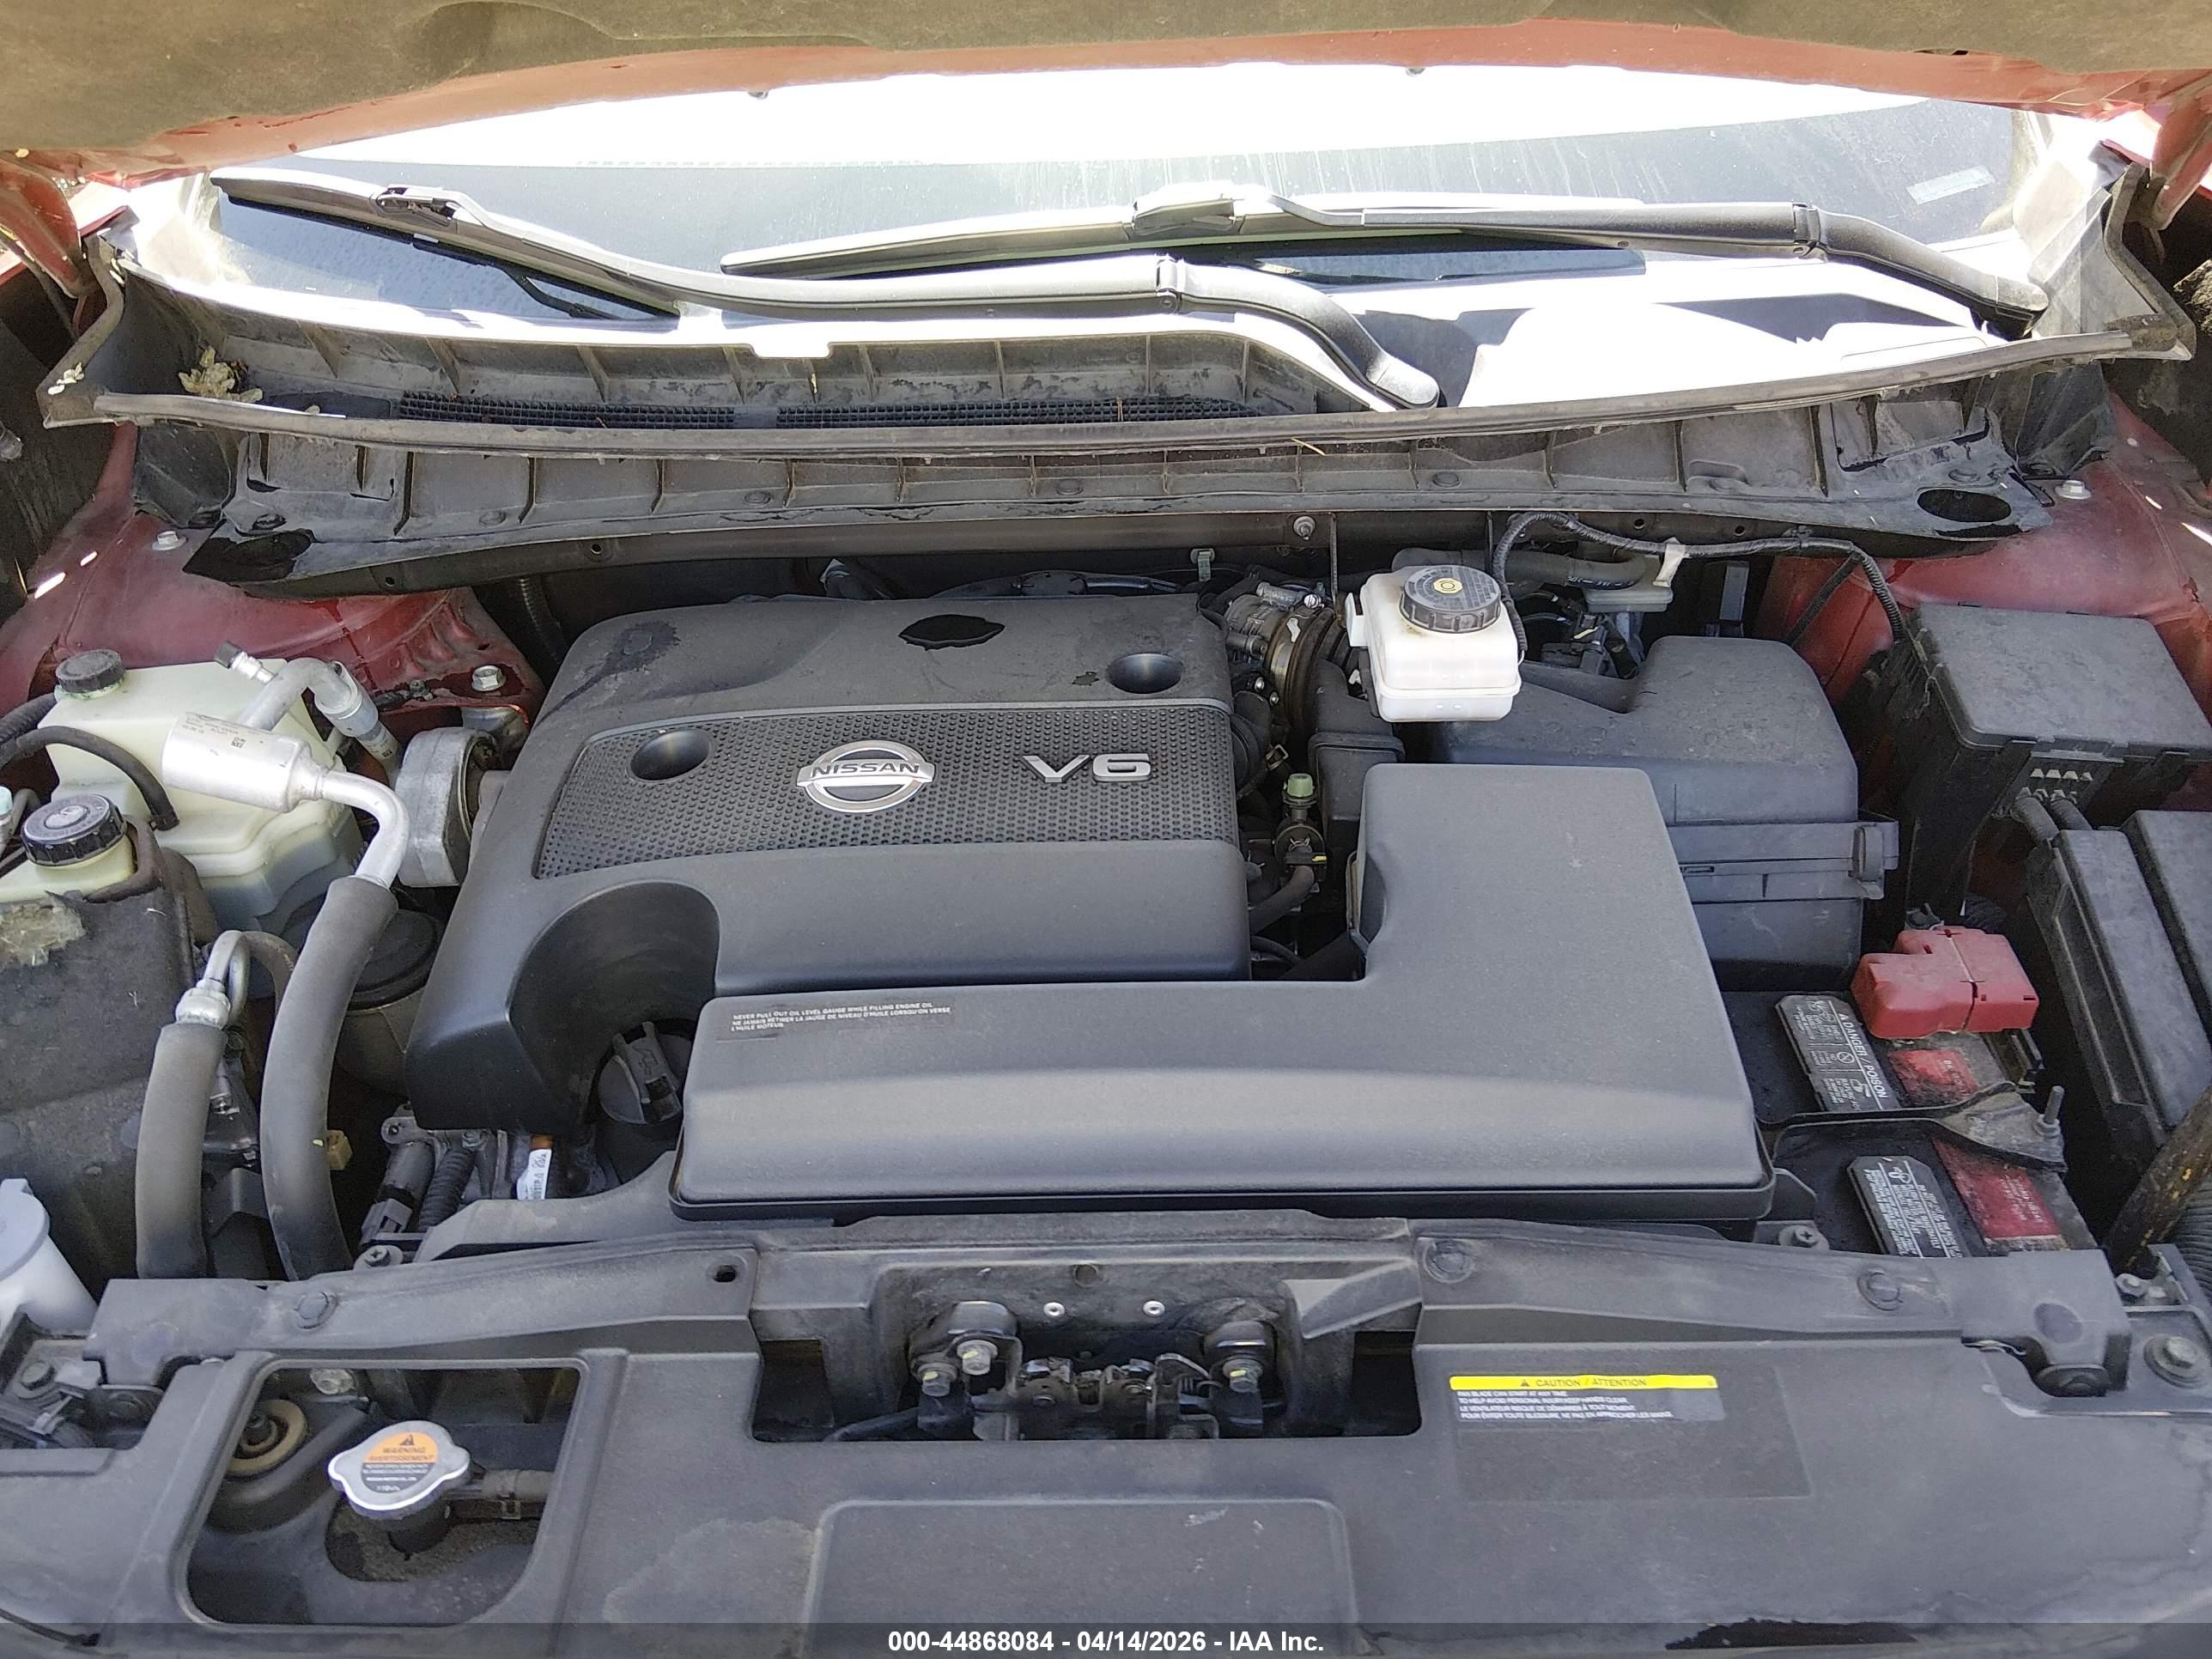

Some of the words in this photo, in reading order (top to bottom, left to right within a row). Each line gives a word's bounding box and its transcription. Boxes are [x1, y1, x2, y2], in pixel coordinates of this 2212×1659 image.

[811, 763, 920, 777] NISSAN
[1021, 752, 1152, 782] V6
[1842, 1022, 1869, 1055] DANGER
[1863, 1065, 1888, 1097] POISON
[1592, 1378, 1647, 1387] ATTENTION
